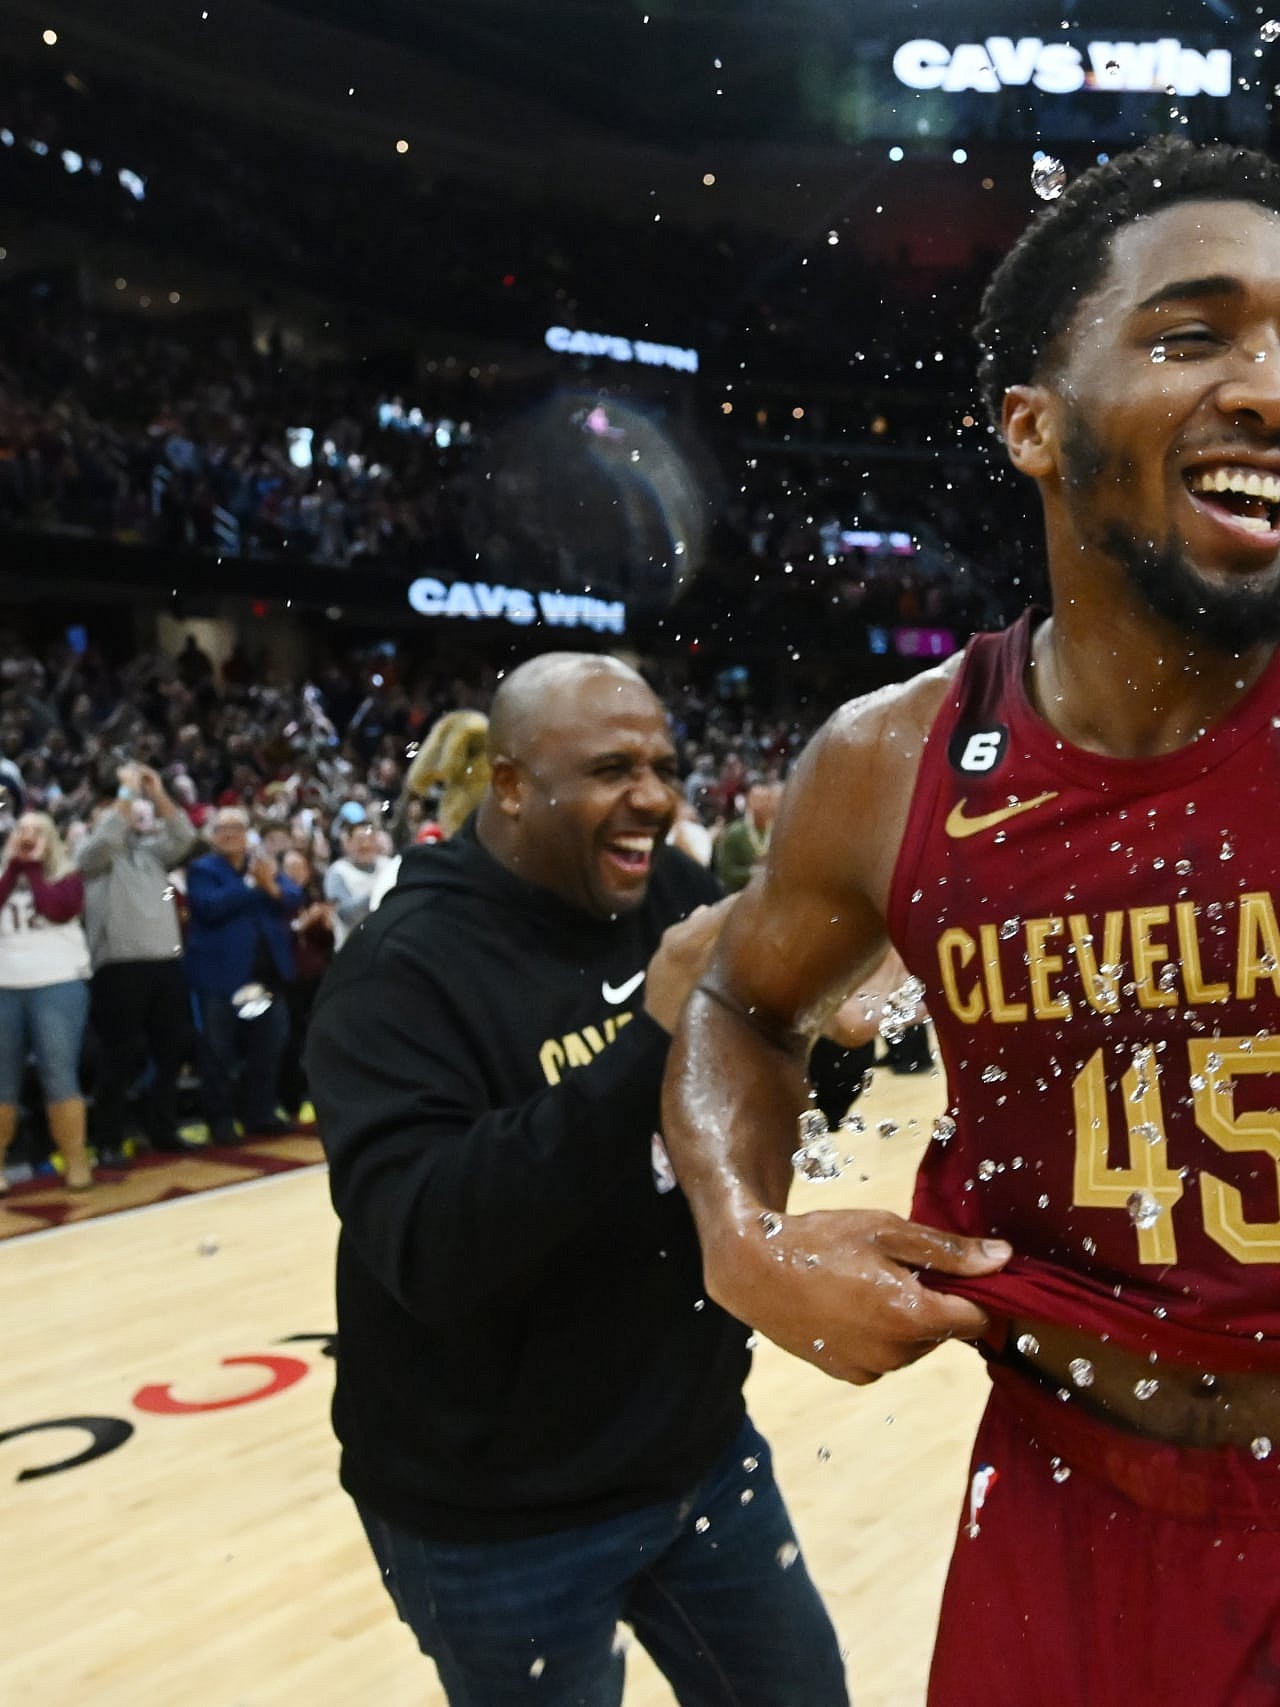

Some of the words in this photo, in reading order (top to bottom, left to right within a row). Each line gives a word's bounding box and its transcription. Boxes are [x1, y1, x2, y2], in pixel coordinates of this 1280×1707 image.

[892, 37, 1086, 93] CAVS
[1087, 38, 1232, 97] WIN
[545, 326, 633, 362] CAVS
[634, 340, 699, 374] WIN
[408, 577, 537, 625] CAVS
[538, 591, 626, 635] WIN
[961, 731, 1001, 771] 6
